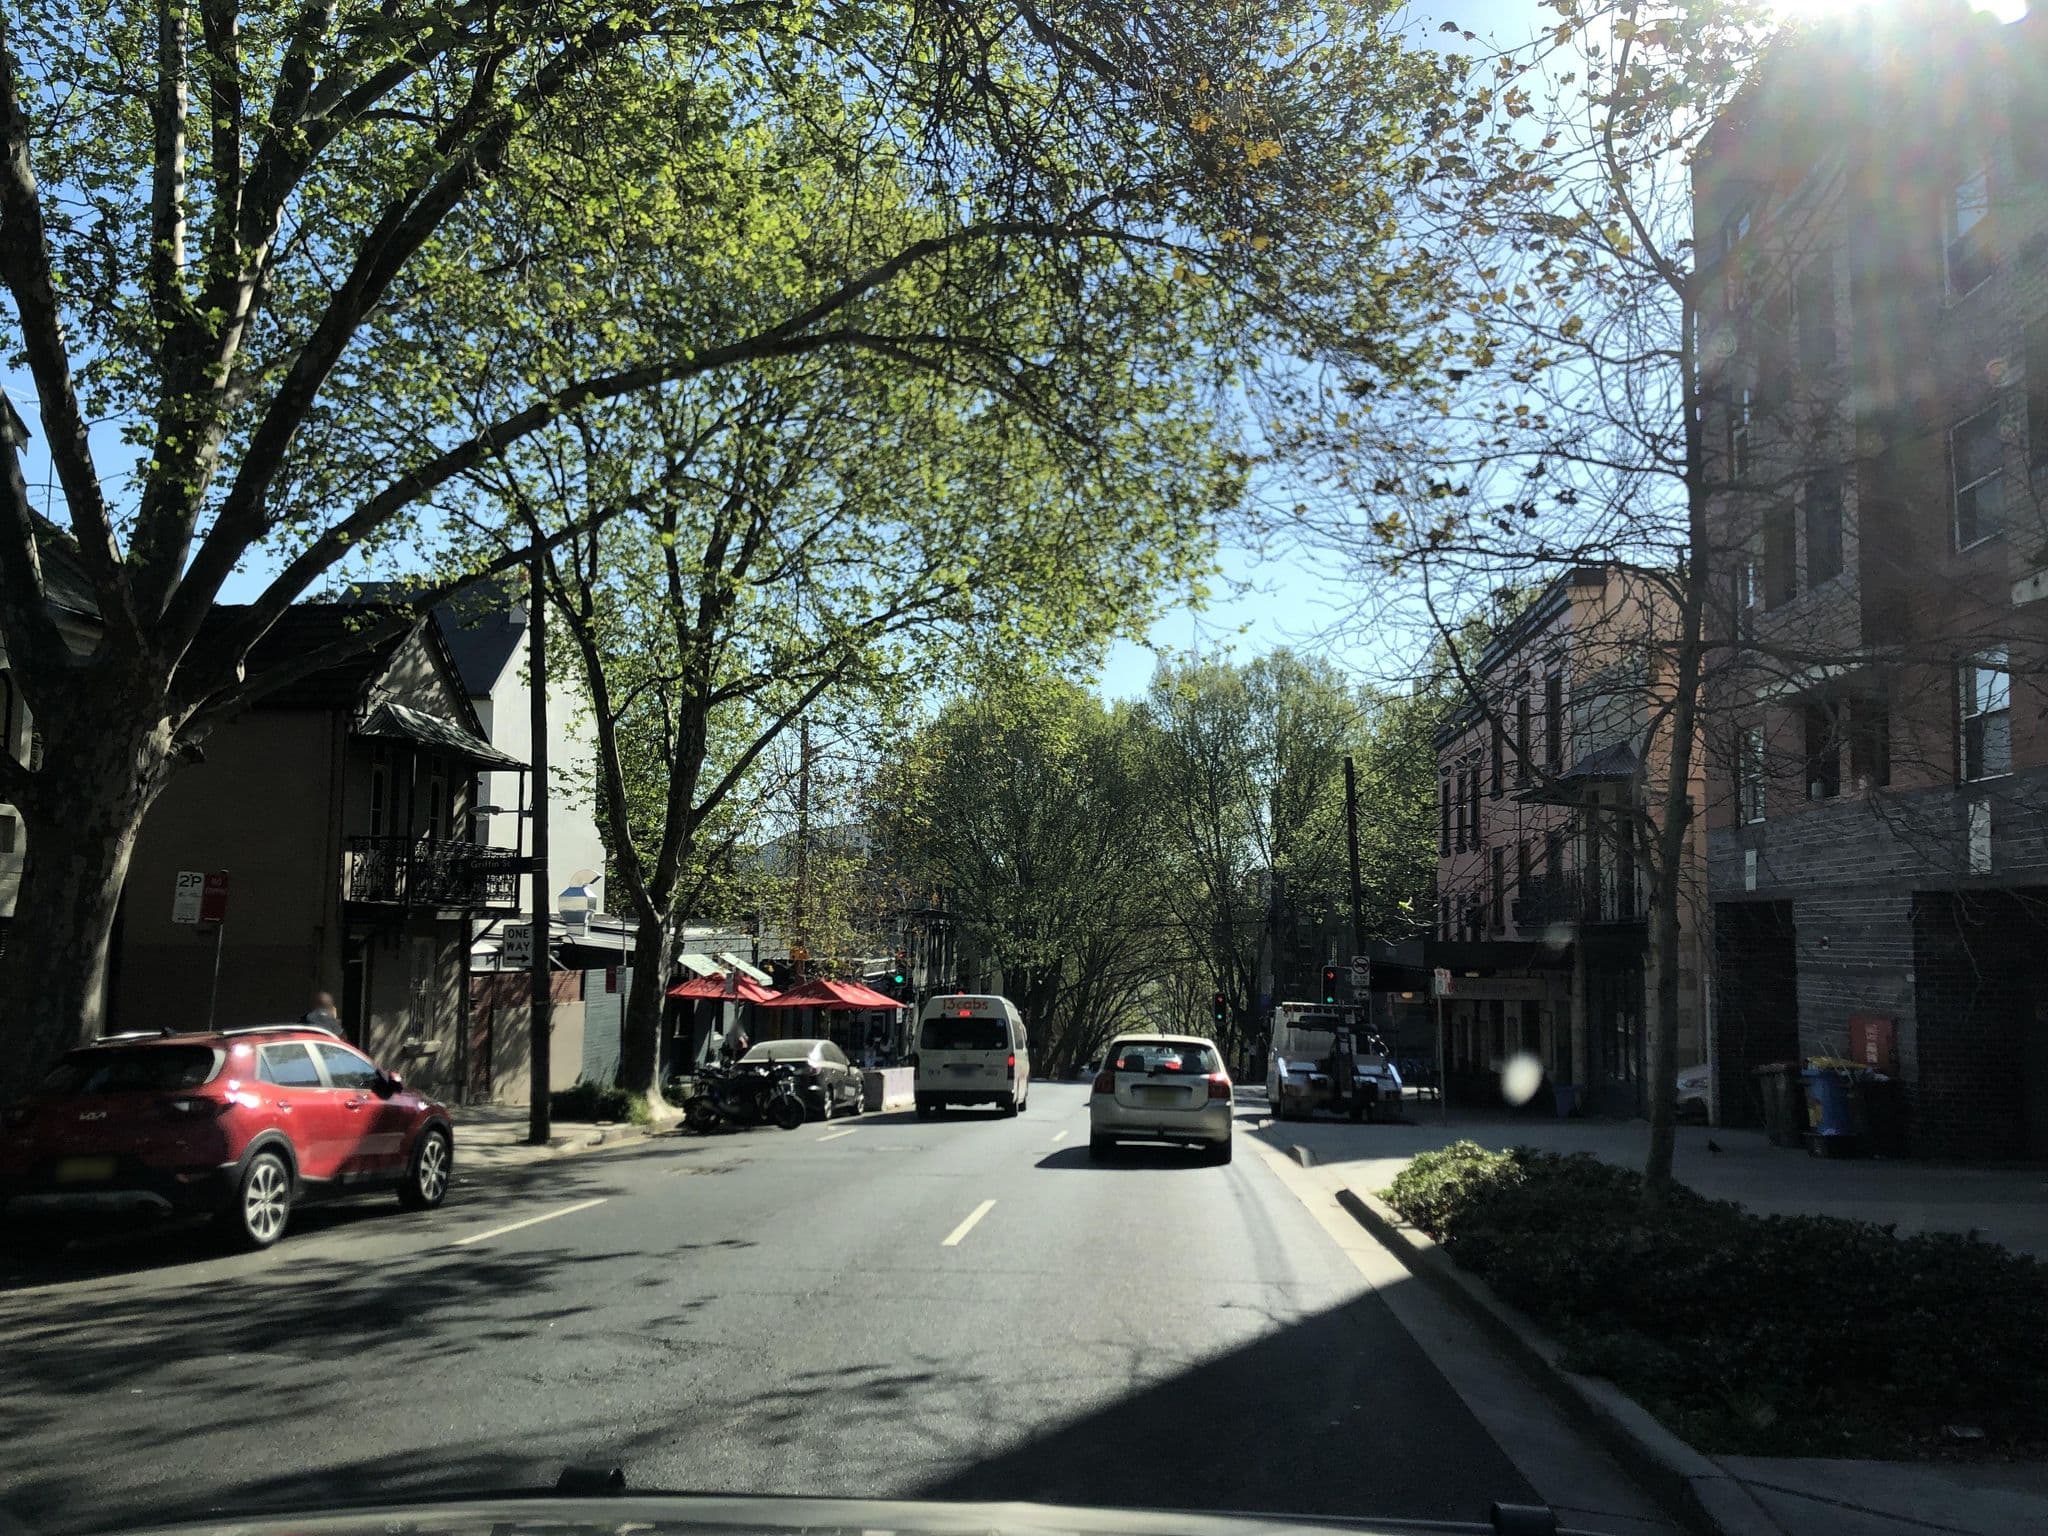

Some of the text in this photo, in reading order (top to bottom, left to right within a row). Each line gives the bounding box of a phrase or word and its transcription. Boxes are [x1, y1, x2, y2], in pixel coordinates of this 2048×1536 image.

[471, 860, 511, 869] Griffin St
[179, 874, 202, 888] 2P
[508, 928, 529, 939] ONE
[506, 942, 530, 952] WAY
[943, 998, 989, 1010] 13cabs
